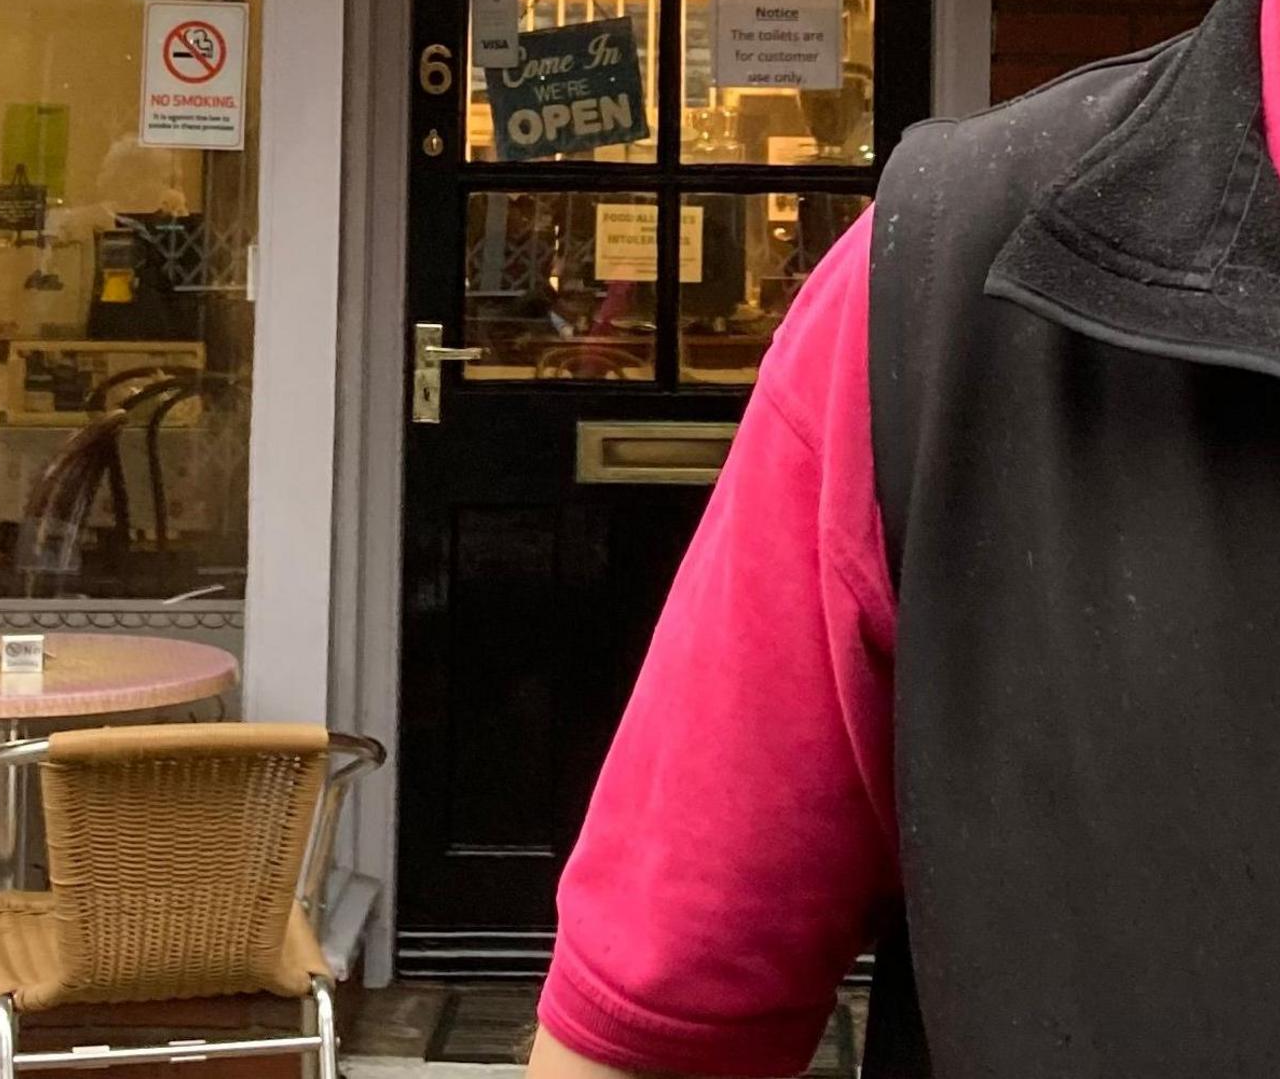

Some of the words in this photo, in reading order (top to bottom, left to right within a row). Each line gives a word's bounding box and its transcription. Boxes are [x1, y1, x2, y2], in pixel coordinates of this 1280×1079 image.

[755, 7, 800, 21] Notice
[731, 29, 754, 41] The
[758, 29, 799, 42] toilets
[802, 32, 824, 42] are
[482, 39, 509, 50] VISA
[584, 32, 621, 70] In
[735, 50, 753, 62] for
[757, 52, 819, 62] customer
[420, 43, 453, 96] 6
[151, 94, 169, 107] NO
[507, 93, 632, 146] OPEN
